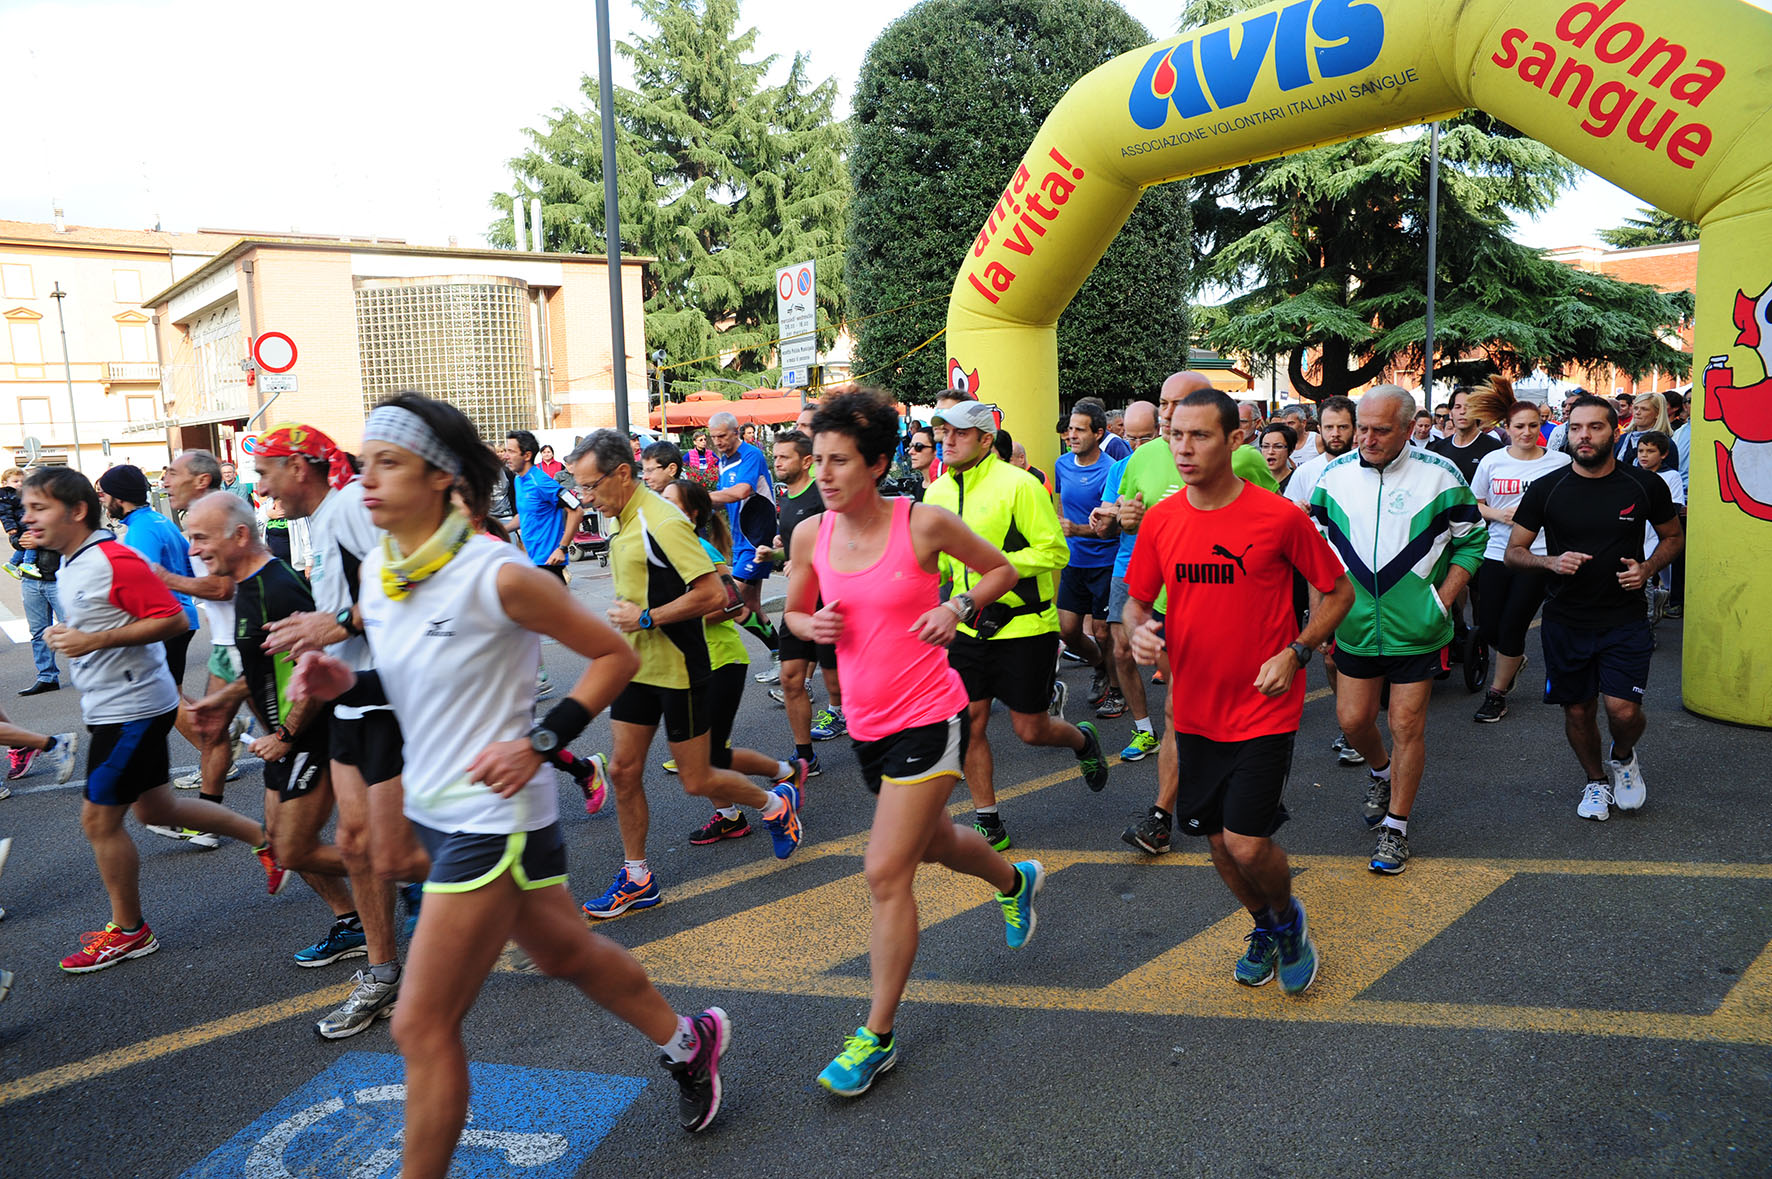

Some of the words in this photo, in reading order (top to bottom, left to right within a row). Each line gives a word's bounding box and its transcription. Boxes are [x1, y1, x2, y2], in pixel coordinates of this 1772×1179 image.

[1129, 0, 1385, 130] AVIS
[1491, 28, 1713, 169] sangue
[1555, 0, 1726, 108] dona
[1121, 128, 1208, 158] ASSOCIAZIONE
[1209, 107, 1286, 136] VOLONTARI
[1287, 89, 1348, 115] ITALIANI
[1350, 68, 1420, 99] SANGUE
[968, 261, 1016, 304] la
[1002, 147, 1085, 256] vita!
[974, 163, 1031, 257] ama
[1493, 479, 1518, 494] WILD
[1176, 563, 1234, 584] PUMA
